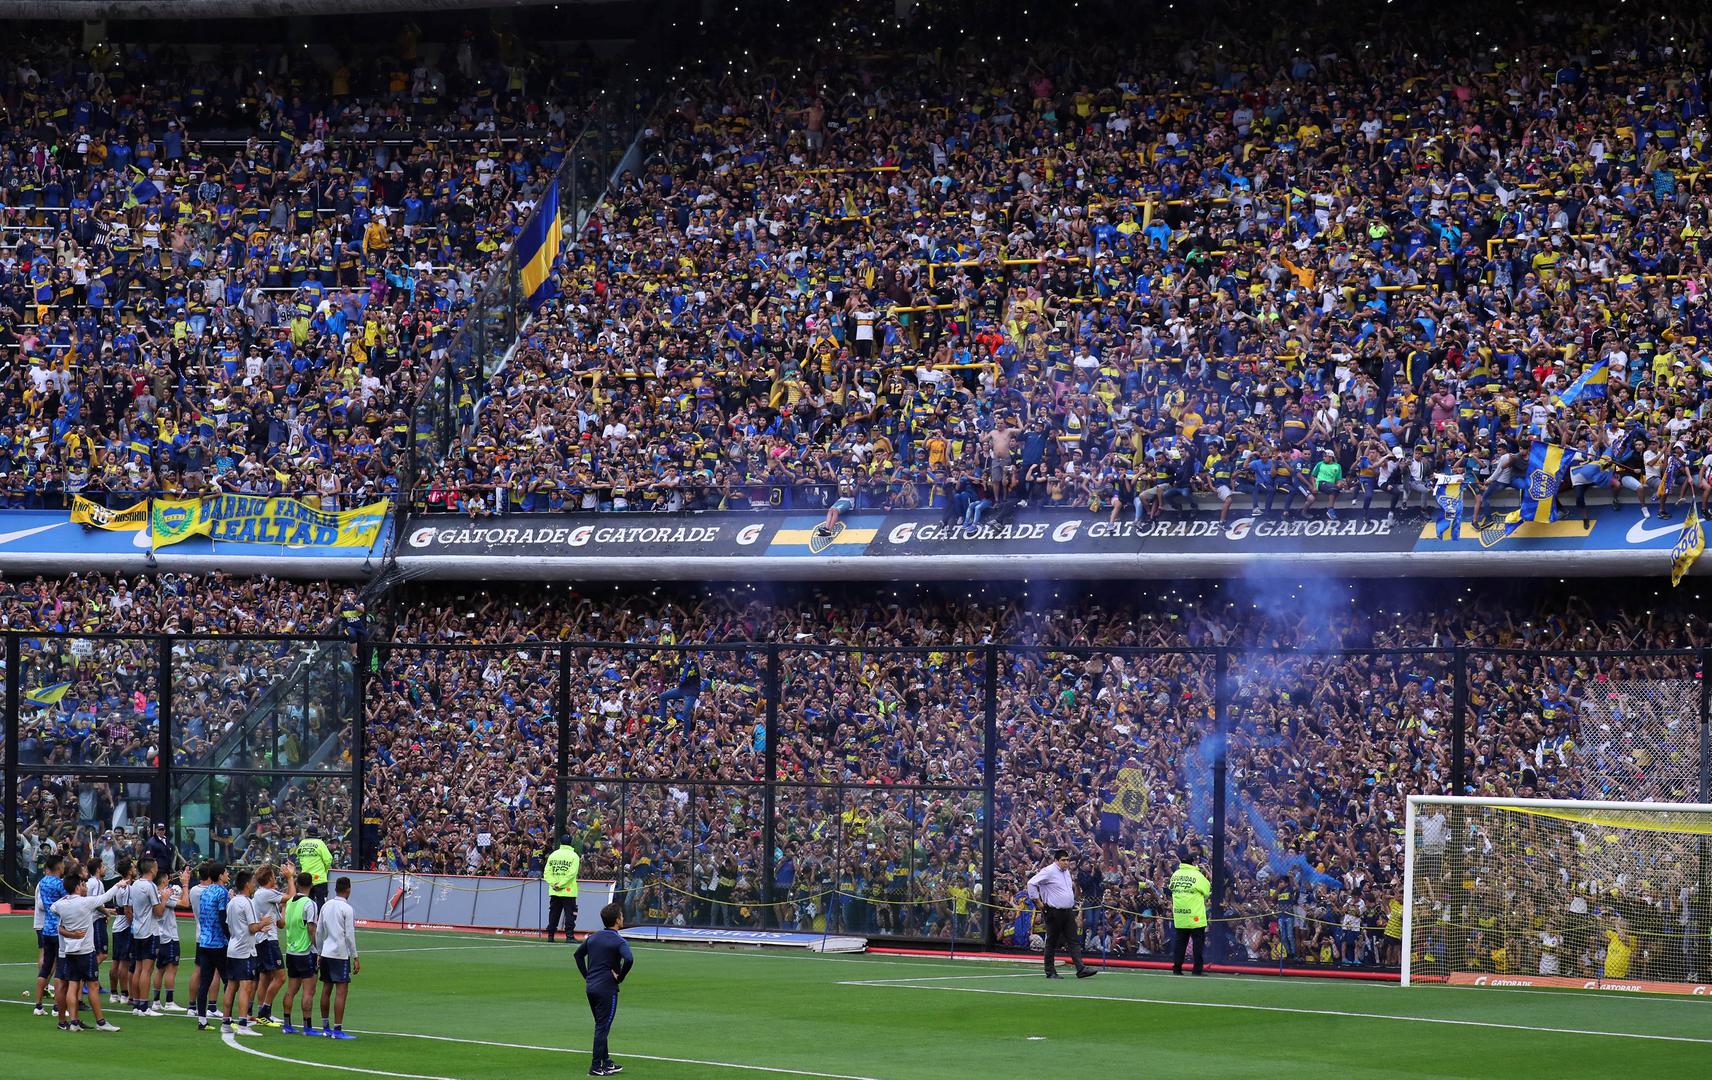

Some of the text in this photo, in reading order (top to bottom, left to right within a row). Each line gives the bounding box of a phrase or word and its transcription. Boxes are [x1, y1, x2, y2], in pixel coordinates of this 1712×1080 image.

[890, 383, 901, 394] 12
[200, 495, 267, 523] BARRIO
[209, 517, 339, 546] LEALTAD
[438, 528, 569, 544] GATORADE
[594, 527, 720, 543] GATORADE
[1255, 519, 1392, 536] GATORADE
